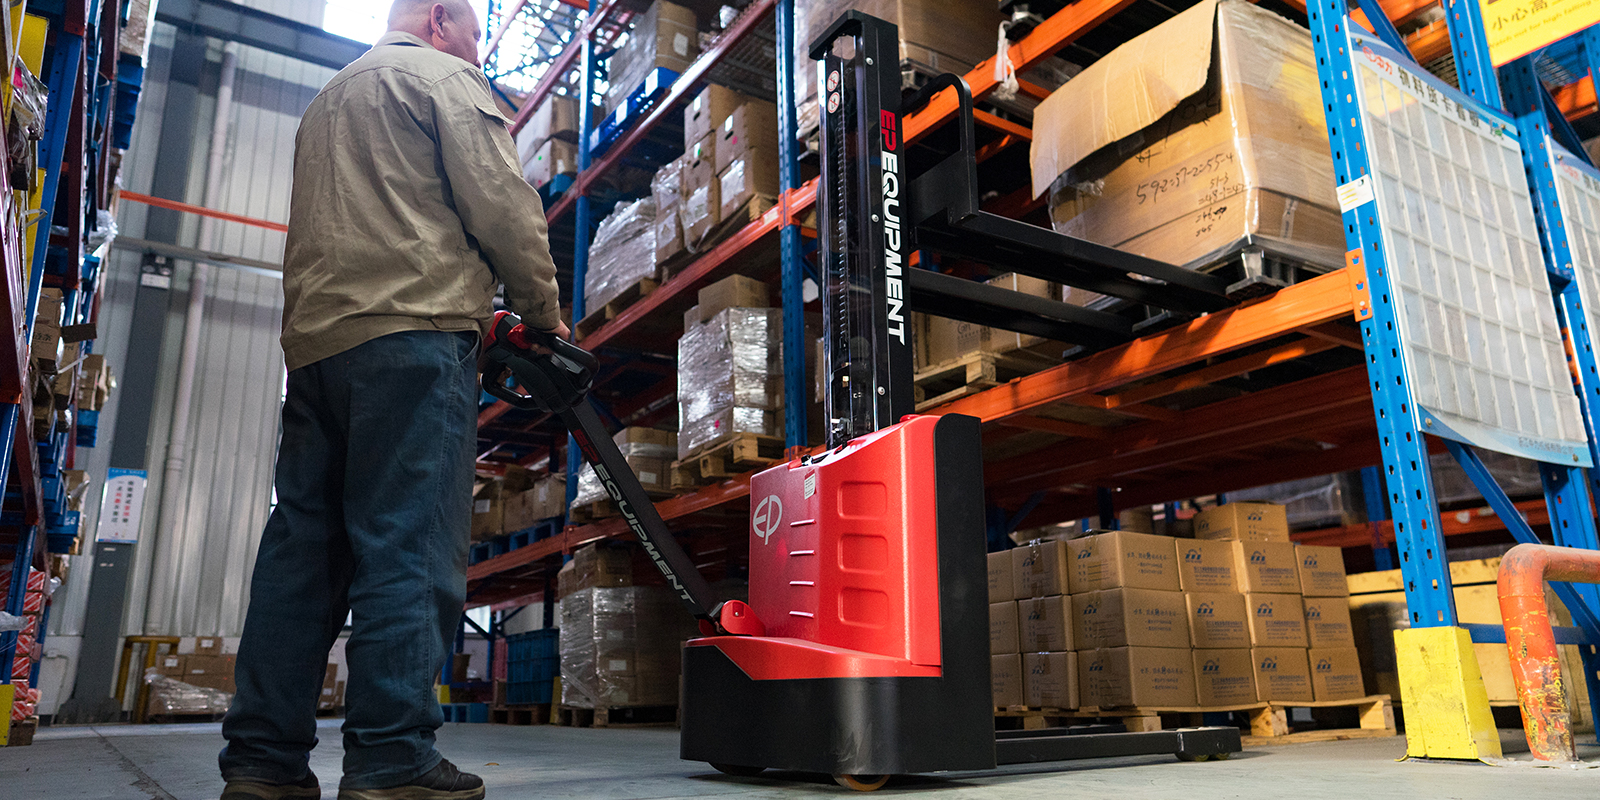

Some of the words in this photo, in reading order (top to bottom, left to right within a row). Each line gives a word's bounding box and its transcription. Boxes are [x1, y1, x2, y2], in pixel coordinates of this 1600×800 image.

[880, 108, 897, 151] EP
[882, 150, 906, 346] EQUIPMENT
[573, 428, 599, 463] EP
[595, 463, 696, 605] EQUIPMENT
[752, 494, 783, 546] EP
